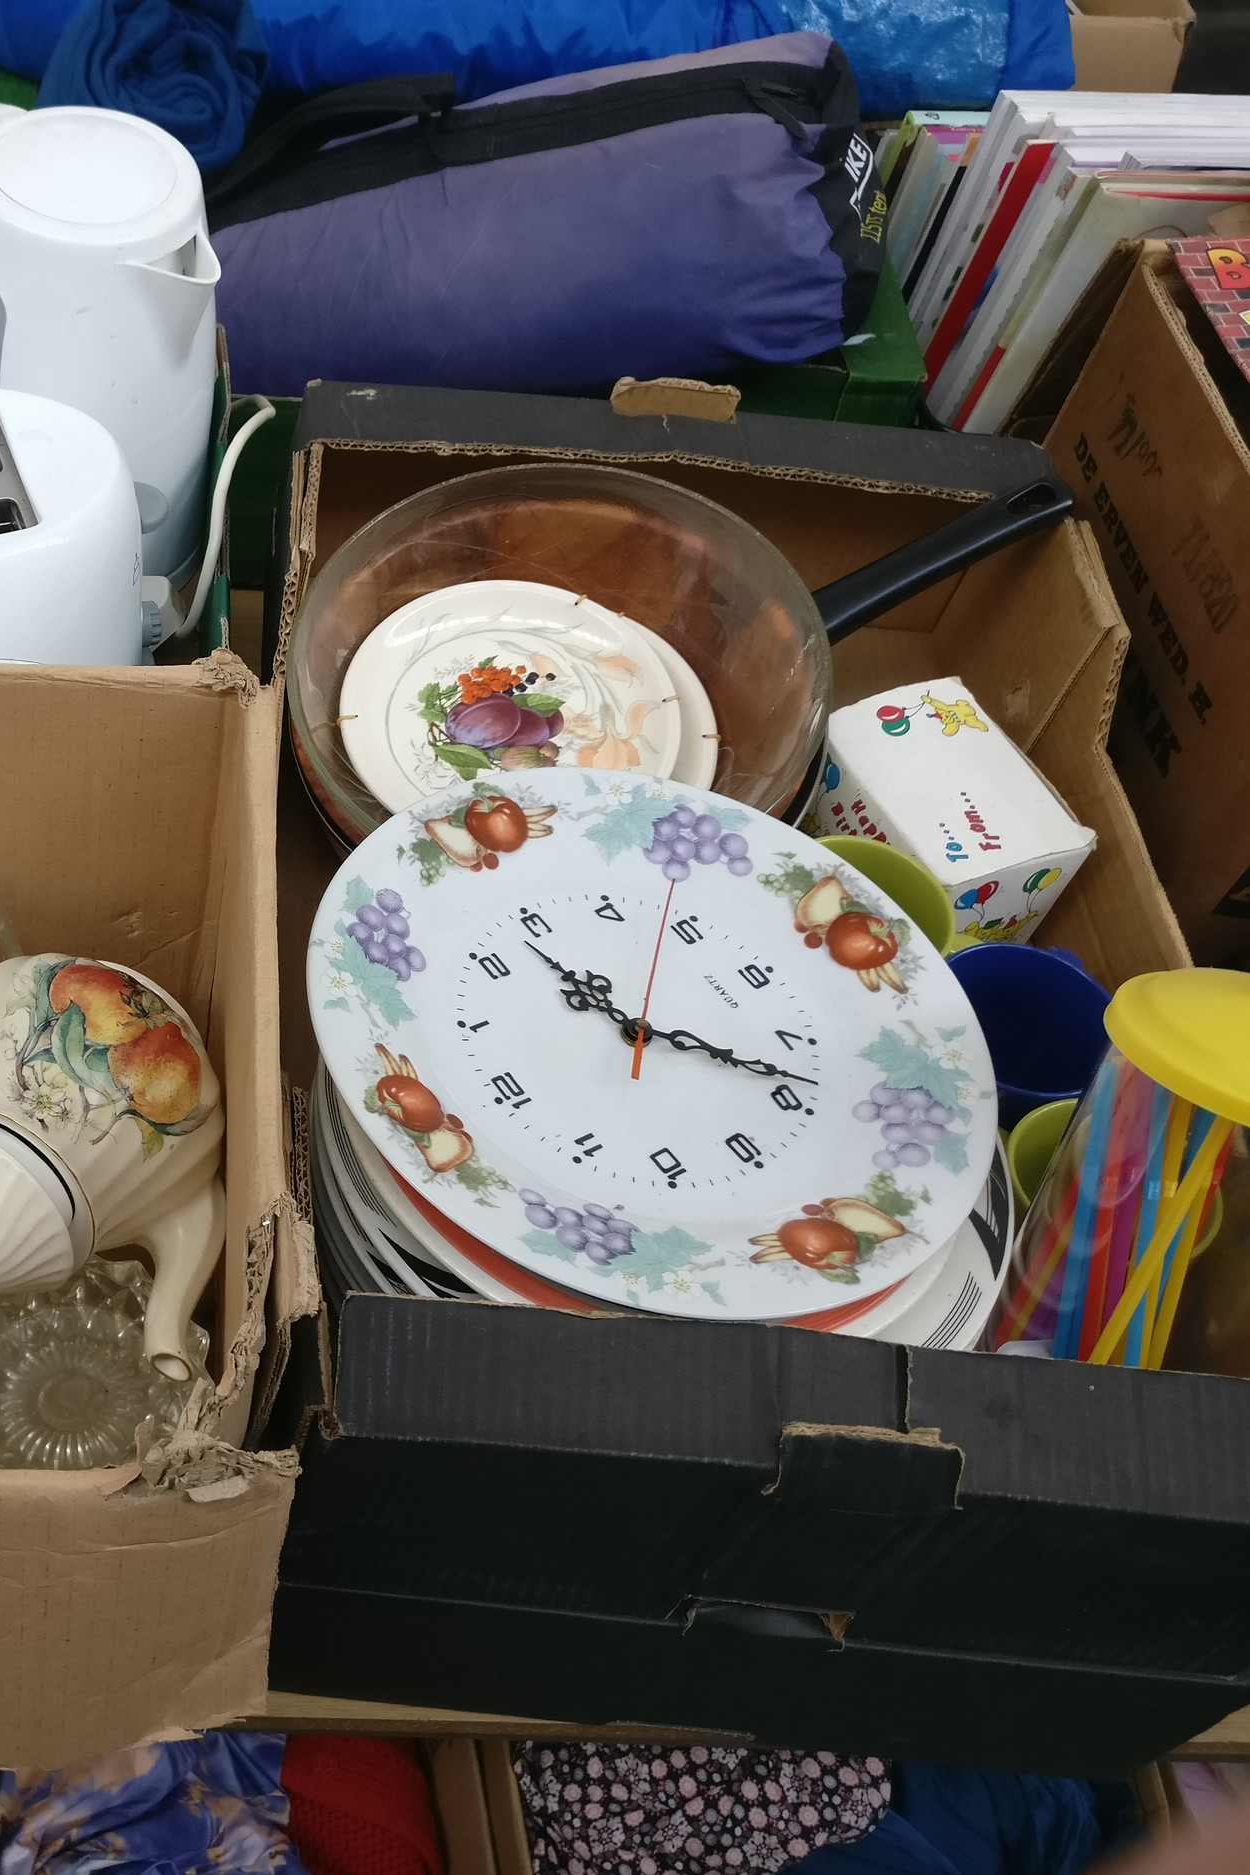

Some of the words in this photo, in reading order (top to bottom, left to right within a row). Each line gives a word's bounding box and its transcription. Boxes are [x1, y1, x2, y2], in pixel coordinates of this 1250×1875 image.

[843, 137, 868, 183] IKE
[1093, 480, 1150, 595] ERVEN
[851, 799, 890, 846] Happ
[520, 912, 553, 938] 3
[594, 902, 626, 923] 4
[670, 919, 704, 945] 5
[478, 952, 511, 980] 2
[737, 964, 771, 990] 6
[703, 975, 739, 1009] QUARTZ
[469, 1020, 490, 1033] 1
[774, 1029, 803, 1051] 7
[490, 1071, 532, 1109] 12
[770, 1084, 803, 1111] 8
[573, 1132, 603, 1158] 11
[725, 1132, 762, 1163] 9
[649, 1147, 687, 1181] 10
